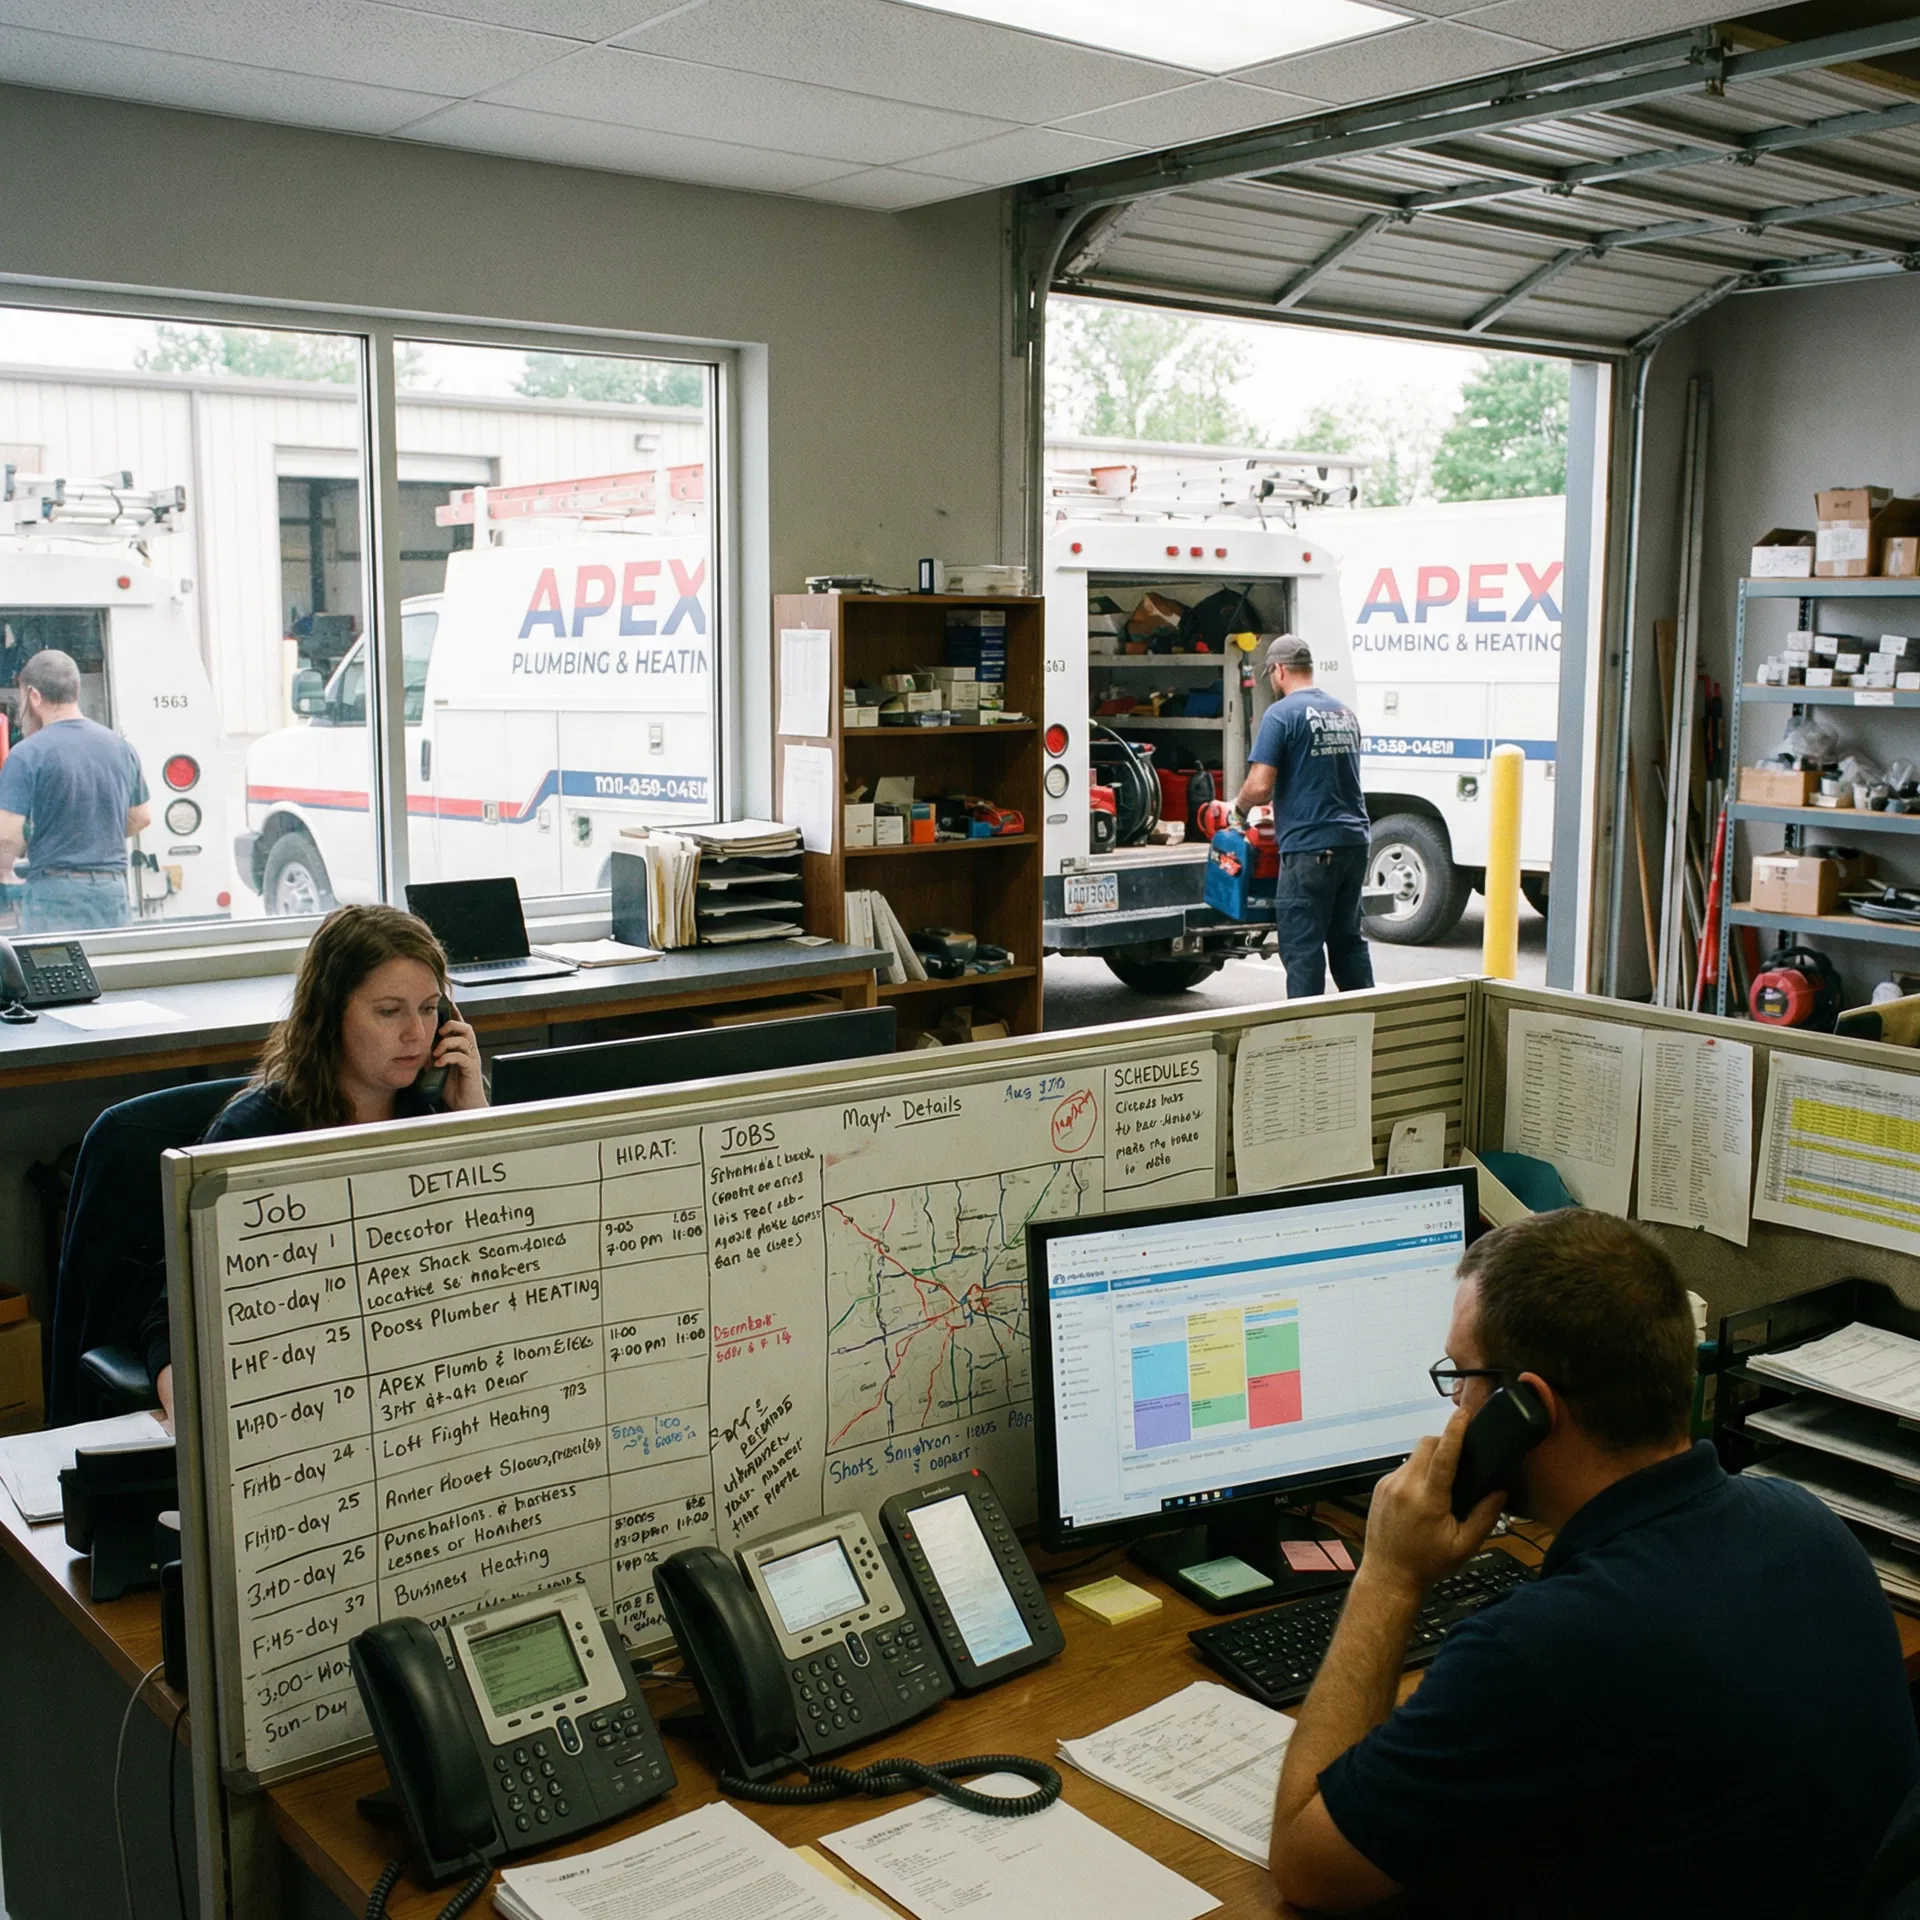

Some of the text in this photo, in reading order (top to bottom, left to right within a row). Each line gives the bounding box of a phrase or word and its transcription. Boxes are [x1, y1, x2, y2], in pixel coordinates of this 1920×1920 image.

[517, 558, 706, 639] APEX
[1356, 561, 1564, 624] APEX
[1352, 633, 1449, 652] PLUMBING
[1457, 634, 1468, 651] &
[512, 651, 610, 674] PLUMBING
[616, 650, 628, 675] &
[152, 695, 189, 709] 1563
[1114, 1060, 1200, 1088] SCHEDULES
[902, 1094, 962, 1121] Details
[720, 1122, 776, 1151] JOBS
[408, 1162, 507, 1198] DETAILS
[242, 1192, 307, 1229] Job
[465, 1205, 536, 1229] Heating
[226, 1242, 318, 1276] Mon-day
[367, 1265, 410, 1286] Apex
[419, 1250, 472, 1273] Shack
[430, 1300, 500, 1329] Plumber
[325, 1325, 351, 1344] 25
[378, 1373, 426, 1399] APEX
[489, 1403, 550, 1427] Heating
[332, 1443, 355, 1463] 24
[337, 1491, 361, 1513] 25
[342, 1544, 366, 1565] 26
[480, 1548, 550, 1578] Heating
